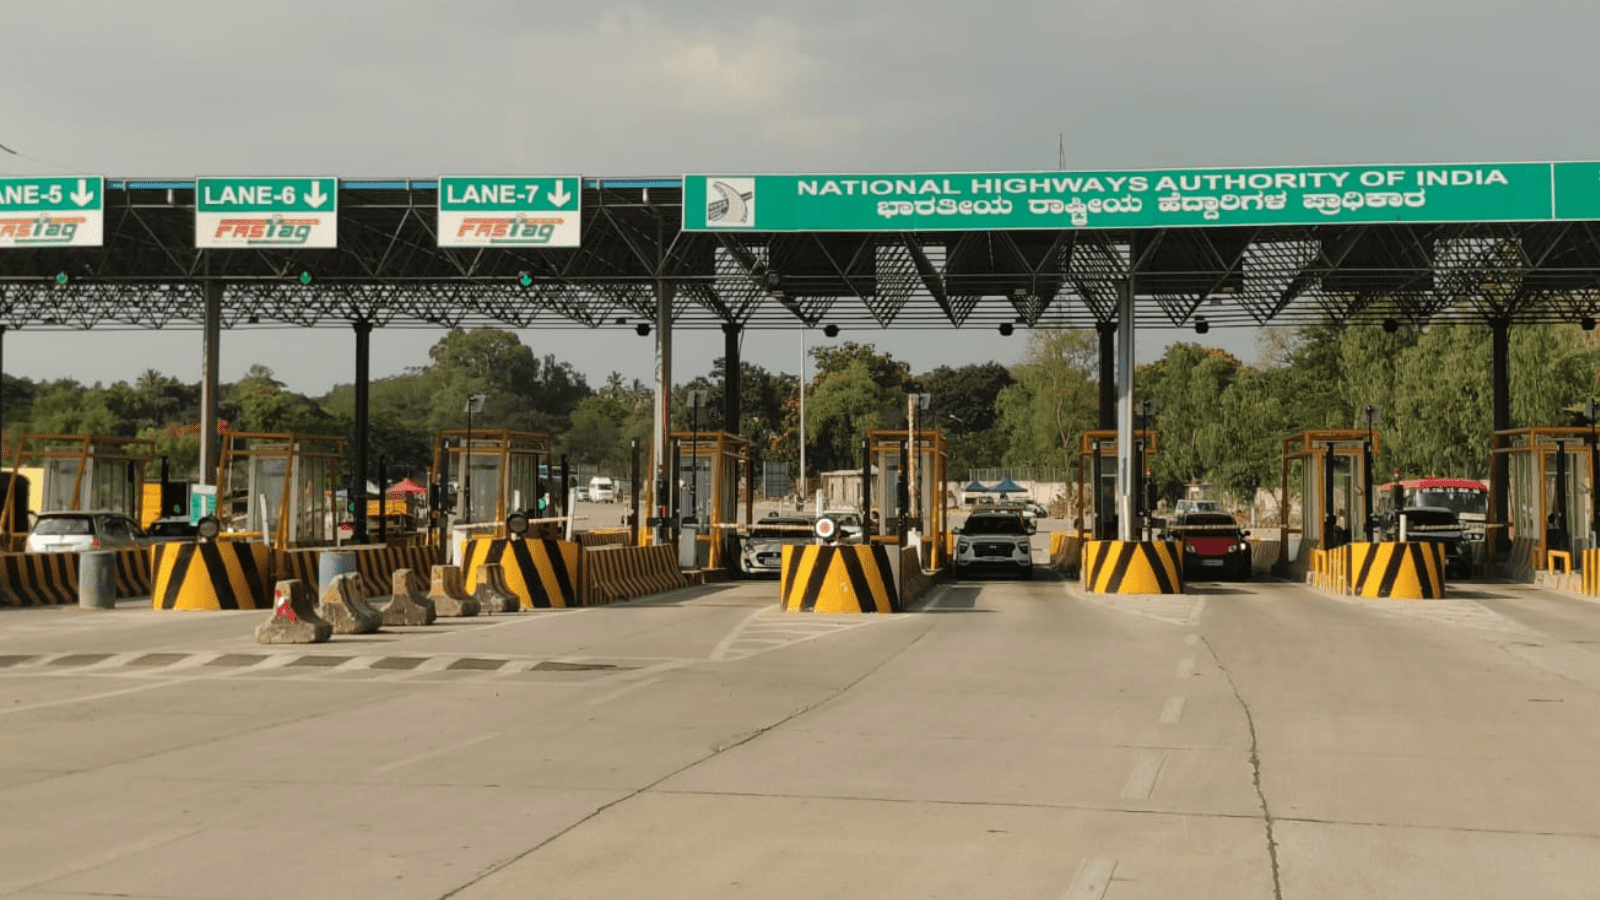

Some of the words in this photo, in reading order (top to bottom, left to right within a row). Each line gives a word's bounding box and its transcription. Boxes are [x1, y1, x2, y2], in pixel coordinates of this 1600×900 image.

[797, 179, 961, 197] NATIONAL
[971, 176, 1149, 195] HIGHWAYS
[1154, 172, 1350, 192] AUTHORITY
[1359, 170, 1406, 187] OF
[1417, 169, 1509, 189] INDIA
[0, 184, 63, 205] NE-5
[204, 185, 296, 205] LANE-6
[447, 184, 539, 204] LANE-7
[876, 195, 1013, 219] ಭಾರತೀಯ
[1027, 193, 1143, 226] ರಾಷ್ಟ್ರೀಯ
[1157, 190, 1287, 220] ಹೆದ್ದಾರಿಗಳ
[1302, 187, 1426, 215] ಪ್ರಾಧಿಕಾರ
